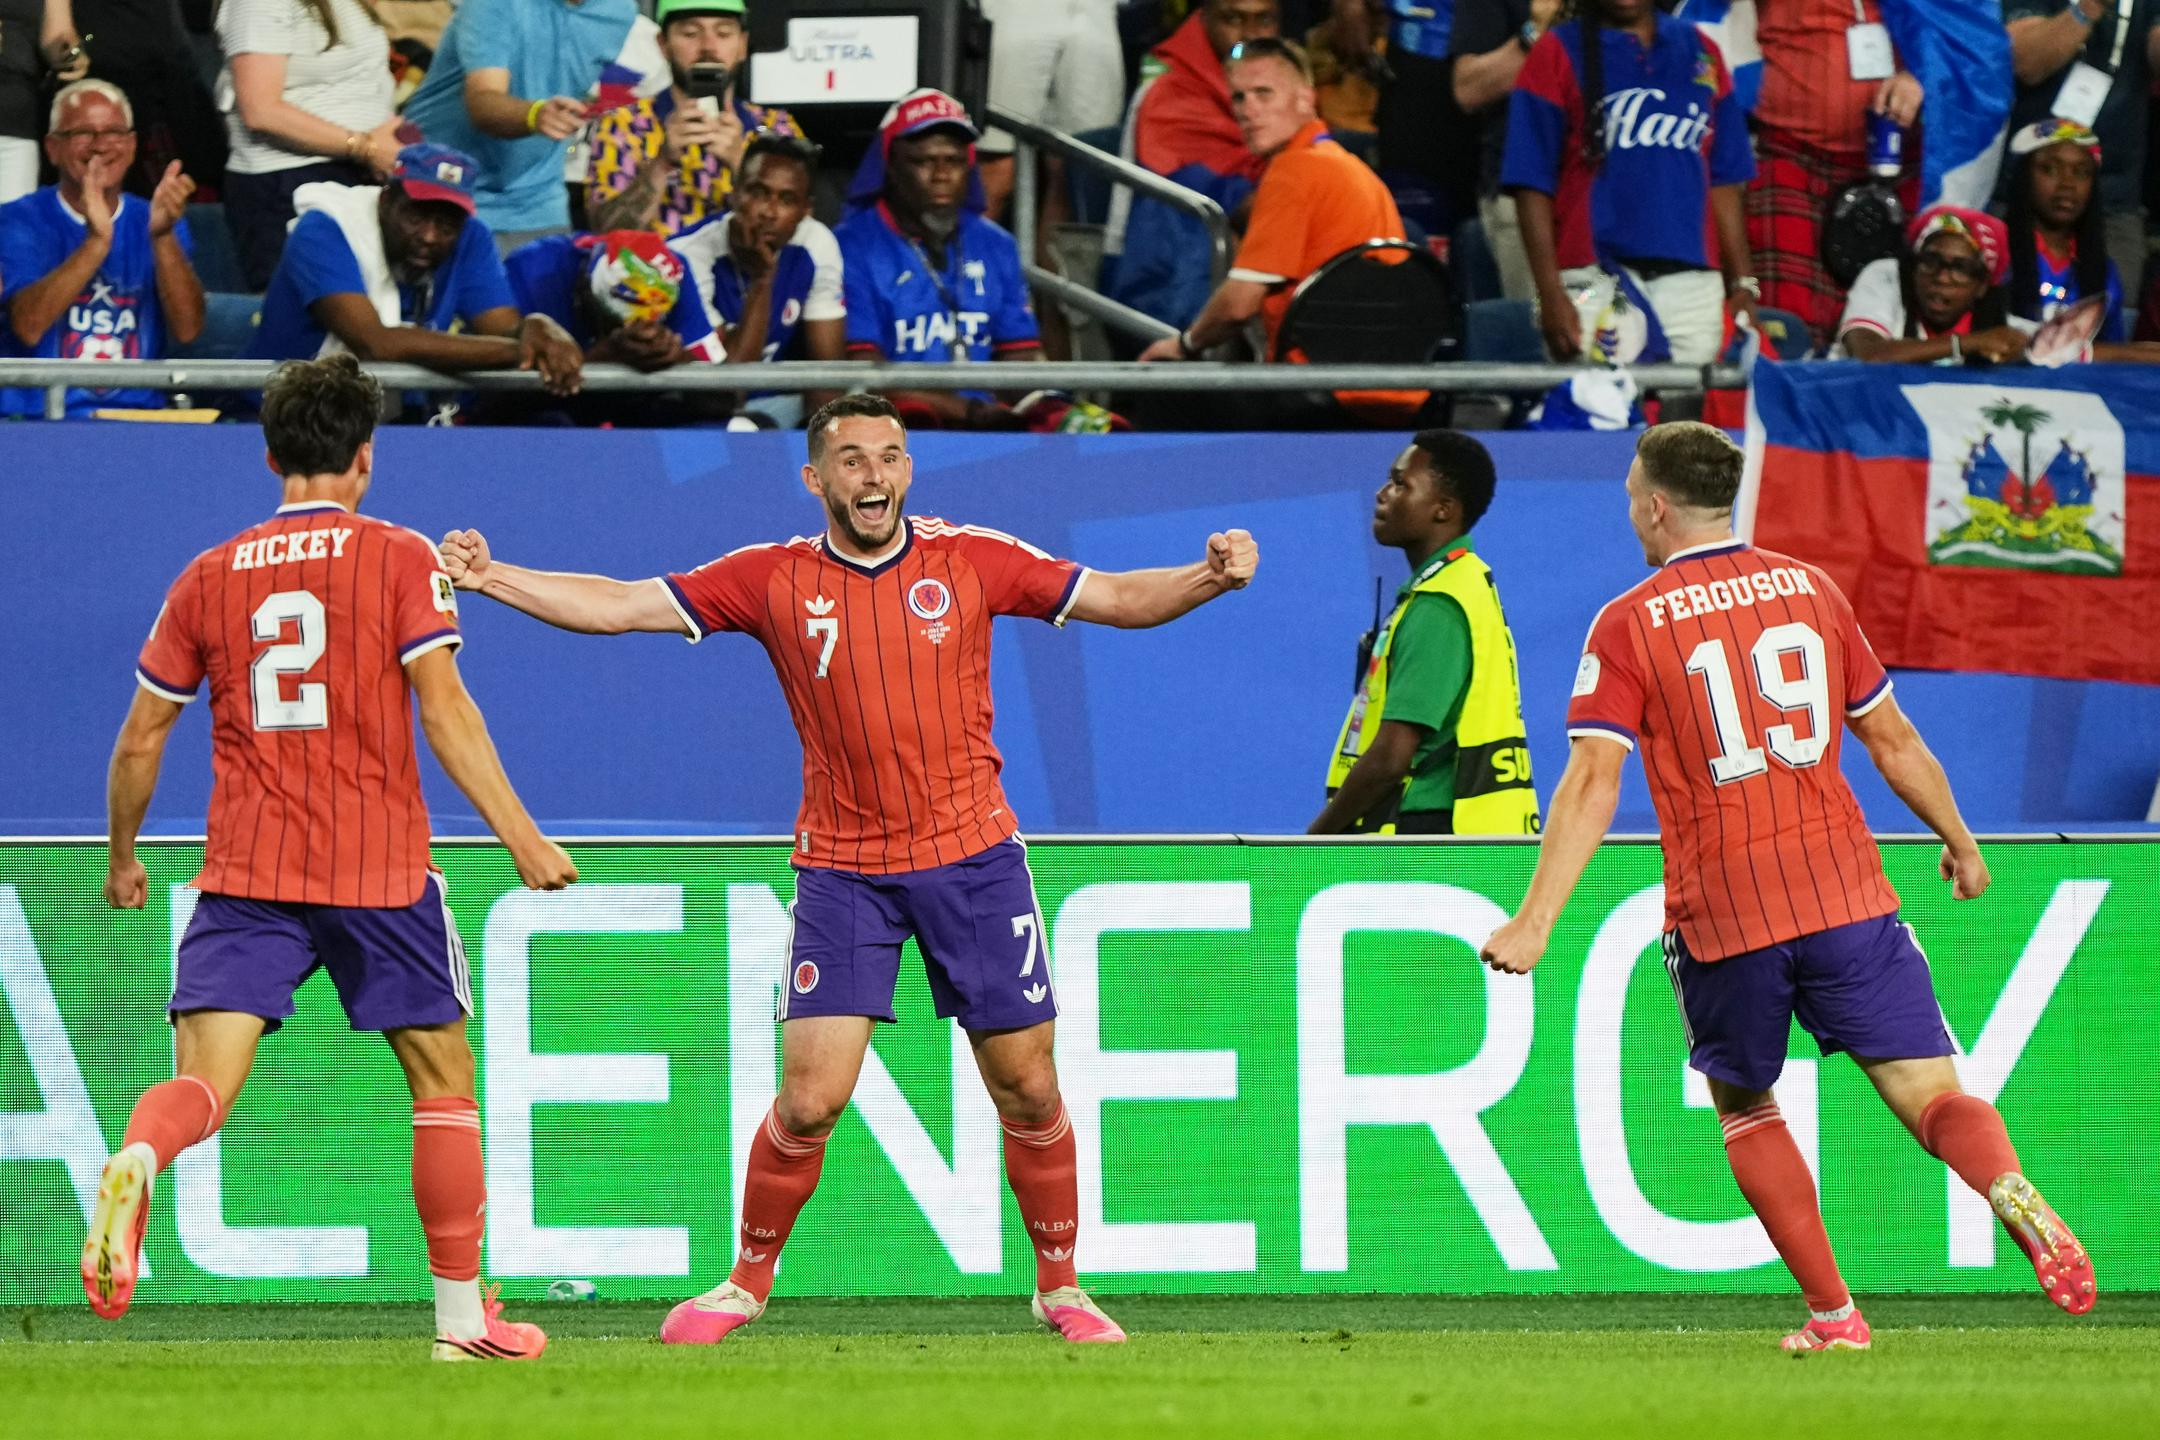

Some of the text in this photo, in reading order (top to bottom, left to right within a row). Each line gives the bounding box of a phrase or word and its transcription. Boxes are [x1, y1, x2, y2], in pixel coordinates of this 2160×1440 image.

[790, 44, 874, 62] ULTRA
[68, 305, 137, 334] USA
[231, 527, 353, 571] HICKEY
[1645, 567, 1817, 628] FERGUSON
[251, 590, 328, 731] 2
[806, 617, 838, 679] 7
[1685, 621, 1831, 787] 19
[1011, 912, 1038, 978] 7
[483, 879, 2111, 1278] ENERGY
[1033, 1219, 1075, 1232] ALBA
